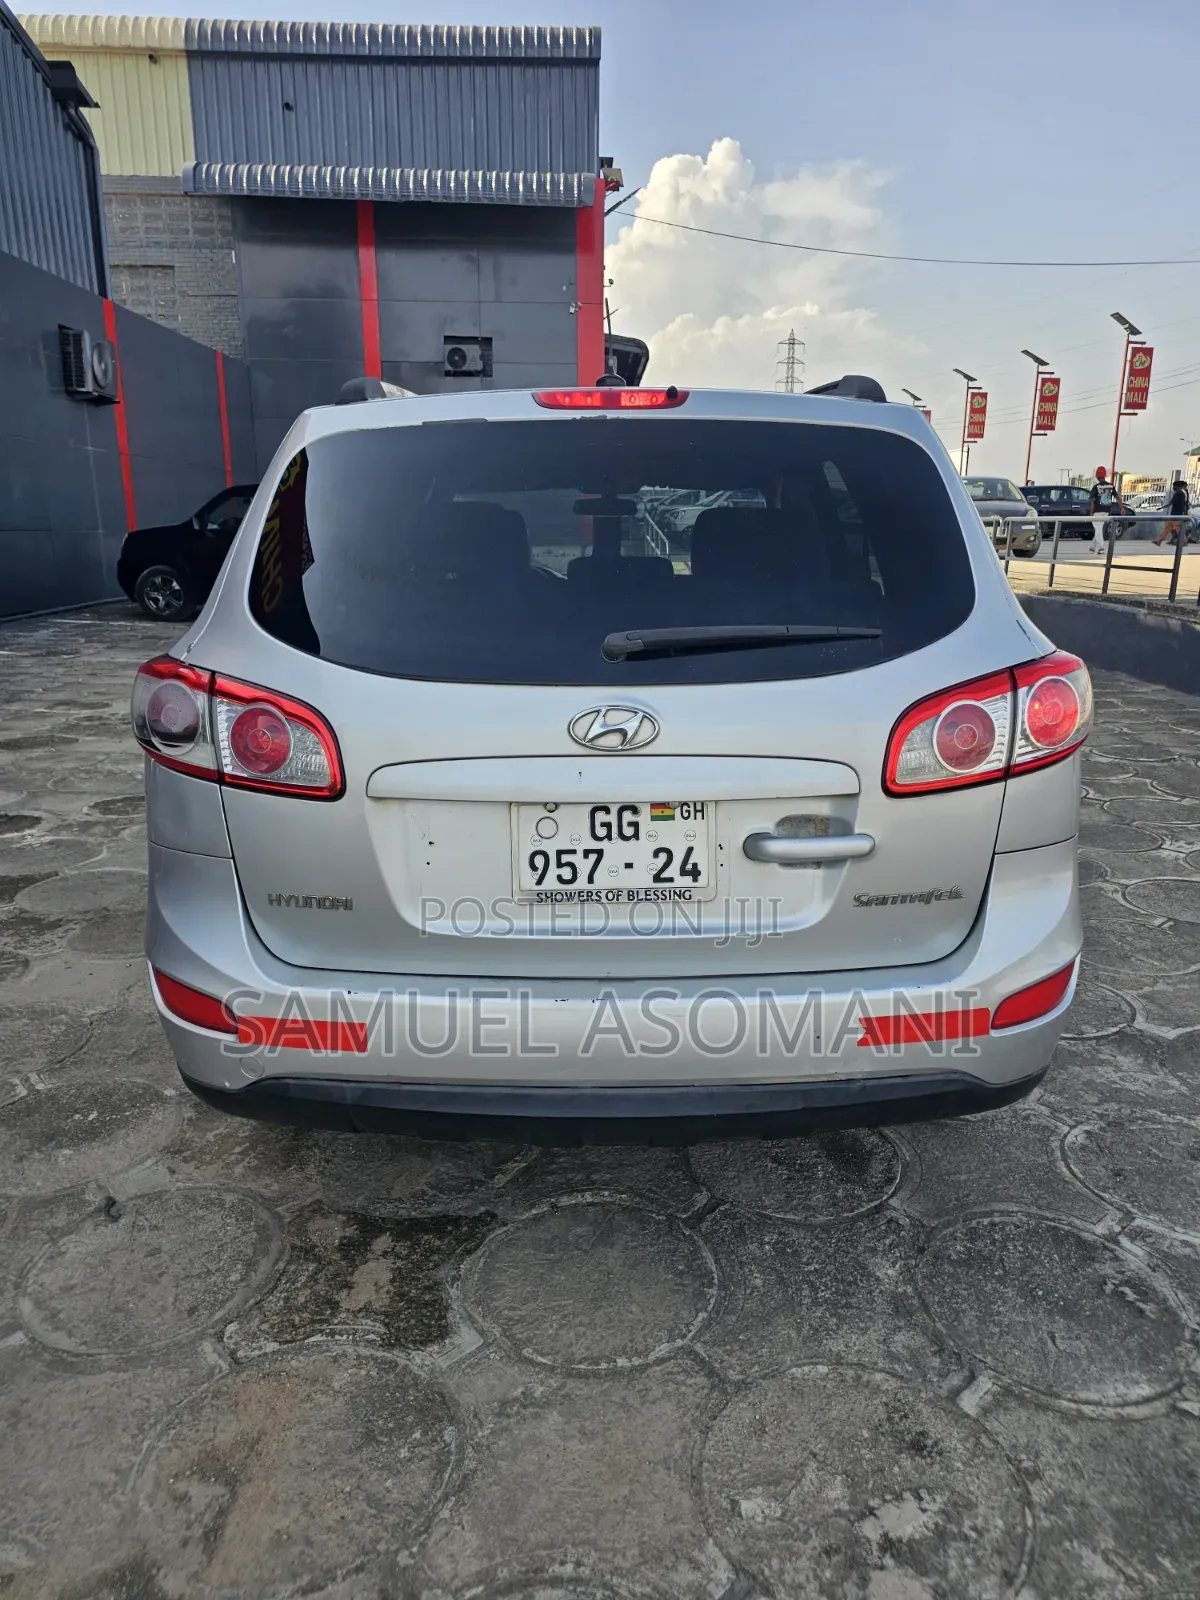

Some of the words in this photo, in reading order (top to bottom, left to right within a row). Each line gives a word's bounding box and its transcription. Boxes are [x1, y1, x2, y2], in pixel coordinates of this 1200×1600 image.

[1128, 376, 1149, 388] CHINA
[1126, 391, 1147, 403] MALL
[1039, 402, 1057, 412] CHINA
[1037, 415, 1056, 425] MALL
[968, 424, 984, 434] MALL
[680, 802, 705, 820] GH
[590, 804, 640, 842] GG
[529, 848, 604, 886] 957
[652, 846, 702, 884] 24
[267, 892, 353, 911] HYUNDAI
[536, 890, 602, 904] SHOWERS
[605, 890, 623, 902] OF
[627, 889, 692, 901] BLESSING
